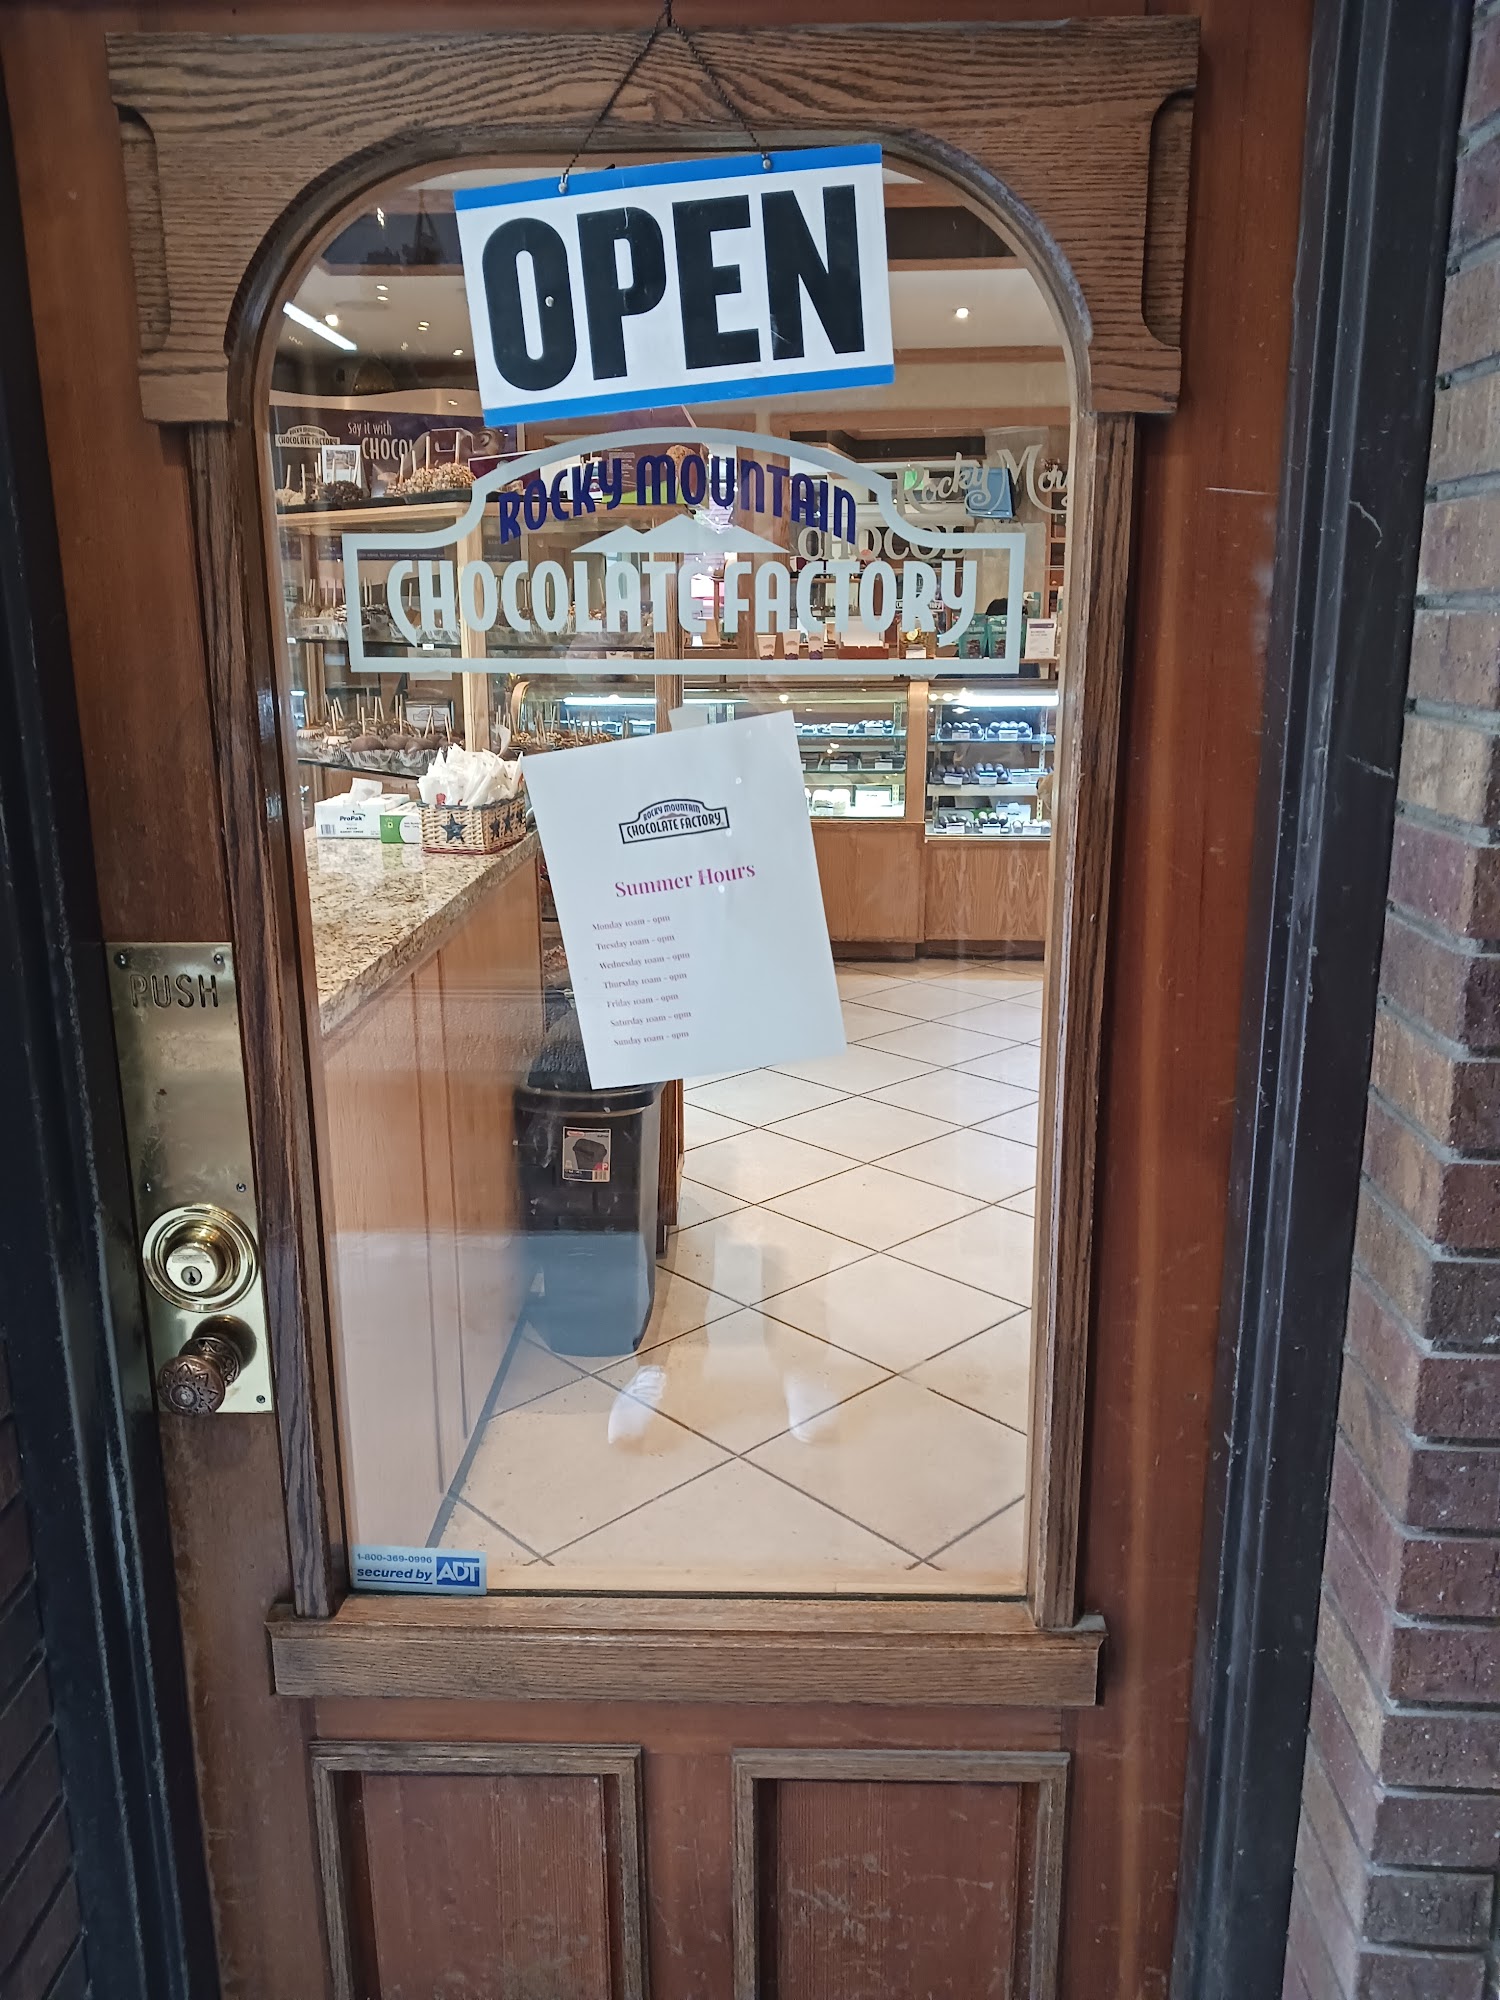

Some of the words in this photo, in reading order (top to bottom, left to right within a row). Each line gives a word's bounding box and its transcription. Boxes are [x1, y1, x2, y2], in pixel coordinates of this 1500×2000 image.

[482, 184, 865, 392] OPEN
[347, 421, 362, 438] say
[364, 420, 371, 435] it
[372, 420, 392, 436] with
[277, 435, 311, 446] CHOCOLATE
[895, 451, 991, 514] Rocky
[498, 458, 622, 545] ROCKY
[635, 453, 857, 544] MOUNTAIN
[387, 560, 711, 648] CHOCOLATE
[724, 560, 978, 647] FACTORY
[643, 806, 663, 822] ROCKY
[664, 803, 701, 814] MOUNTAIN
[626, 819, 679, 839] CHOCOLATE
[680, 812, 721, 830] FACTORY
[614, 872, 693, 898] Summer
[697, 863, 756, 887] Hours
[592, 921, 622, 931] Monday
[625, 918, 645, 927] 10am
[652, 915, 671, 924] 9pm
[596, 940, 627, 951] Tuesday
[629, 938, 650, 946] 10am
[656, 934, 676, 945] 9pm
[600, 958, 642, 970] Wednesday
[644, 956, 665, 964] 10am
[672, 952, 690, 962] 9pm
[603, 978, 639, 990] Thursday
[641, 976, 662, 985] 10am
[669, 972, 688, 983] 9pm
[129, 972, 220, 1010] PUSH
[606, 998, 631, 1008] Friday
[633, 996, 654, 1006] 10am
[660, 993, 679, 1003] 9pm
[610, 1017, 644, 1028] Saturday
[646, 1014, 666, 1024] 10am
[673, 1011, 692, 1021] 9pm
[613, 1036, 642, 1046] Sunday
[644, 1034, 664, 1044] 10am
[671, 1030, 690, 1041] 9pm
[356, 1553, 433, 1564] 1-800-369-0996
[356, 1567, 413, 1579] secured
[415, 1569, 433, 1582] by
[437, 1561, 479, 1582] ADT
